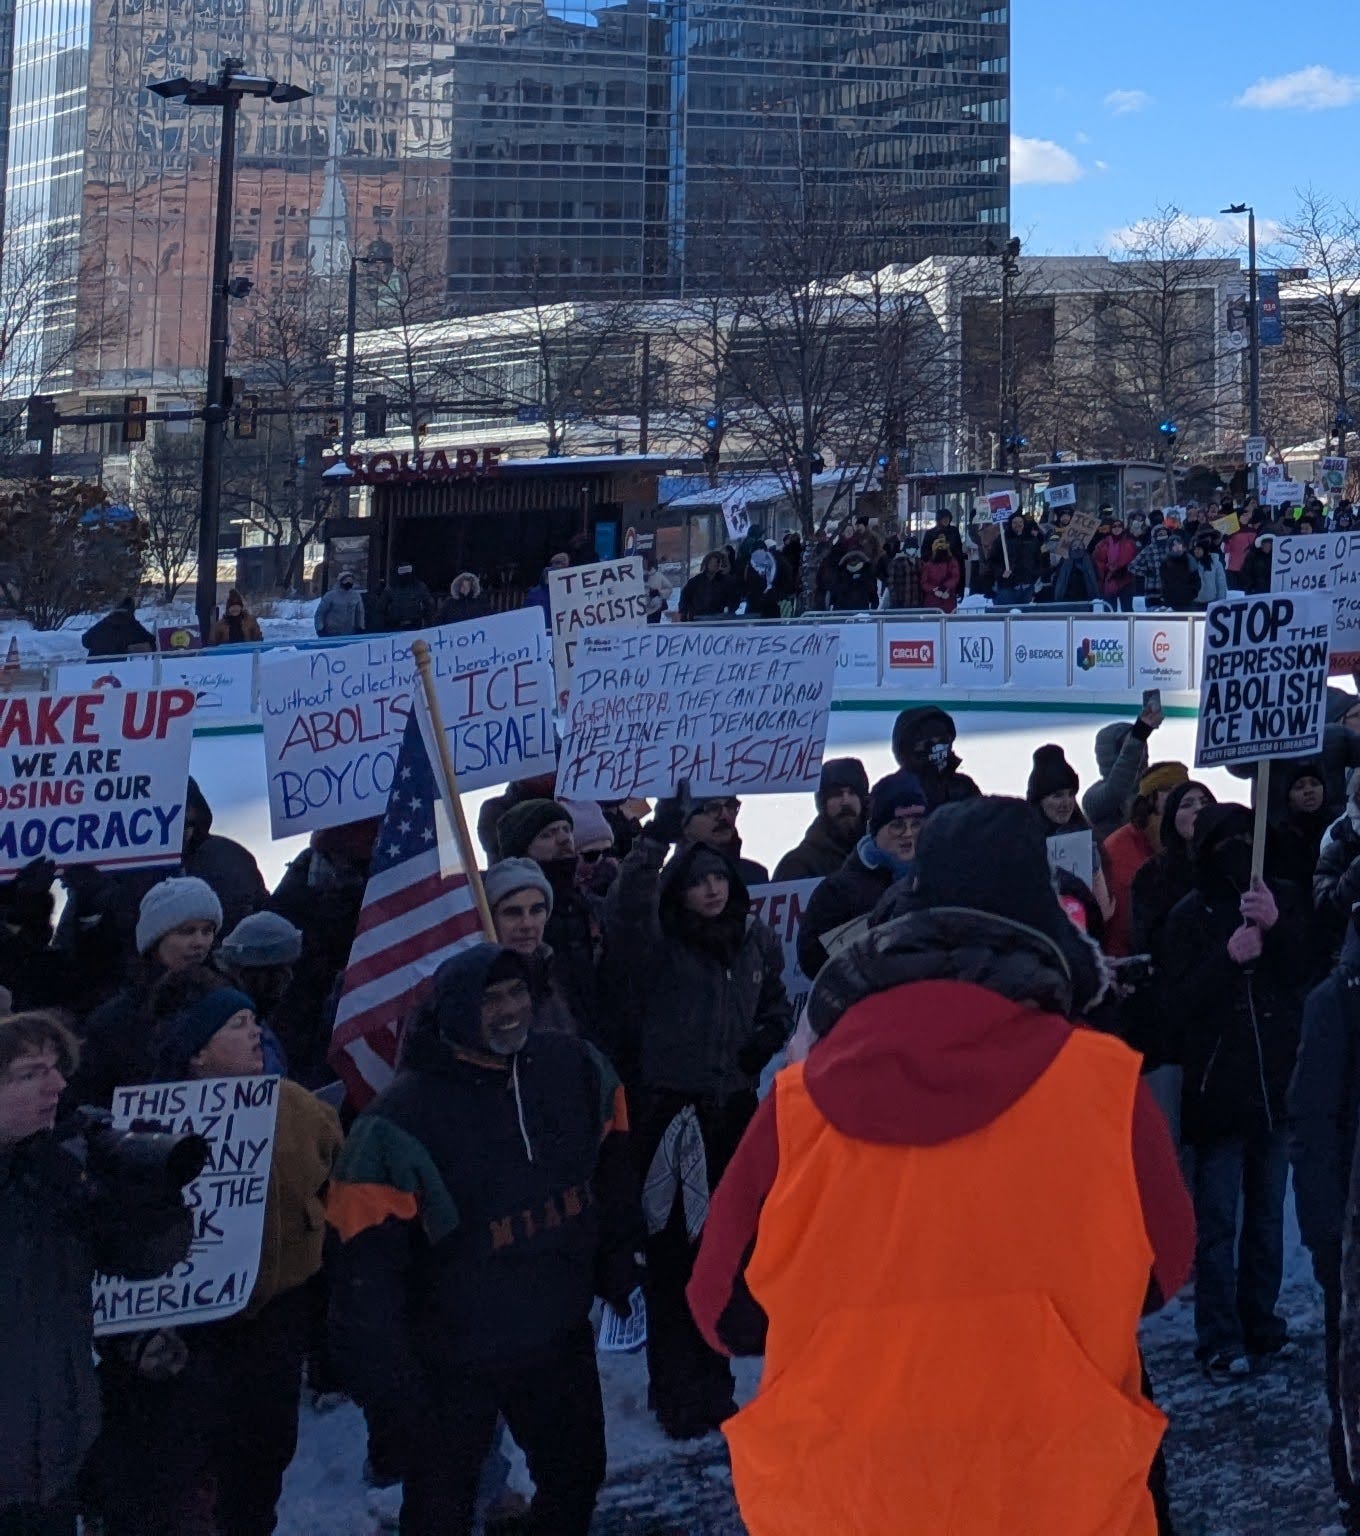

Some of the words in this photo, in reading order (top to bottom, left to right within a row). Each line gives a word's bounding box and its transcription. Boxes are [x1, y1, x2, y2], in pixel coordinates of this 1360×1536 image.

[1249, 451, 1262, 462] 10
[1278, 538, 1327, 565] SOME
[558, 564, 635, 594] TEAR
[1275, 567, 1327, 591] THOSE
[556, 593, 648, 635] FASCISTS
[1208, 599, 1294, 648] STOP
[622, 635, 652, 661] IF
[1091, 638, 1119, 651] BLOCK
[1287, 624, 1328, 641] THE
[435, 635, 542, 678] Liberation!
[959, 636, 994, 663] K&D
[1028, 649, 1064, 660] BEDROCK
[1096, 651, 1124, 663] BLOCK
[1204, 641, 1328, 681] REPRESSION
[577, 669, 650, 694] DRAW
[658, 662, 709, 685] THE
[716, 661, 761, 684] LINE
[767, 661, 803, 681] AT
[1203, 669, 1325, 716] ABOLISH
[279, 693, 410, 760] ABOLIS
[452, 659, 538, 721] ICE
[676, 692, 721, 713] THEY
[772, 680, 823, 706] DRAW
[121, 688, 195, 740] UP
[615, 718, 675, 746] LINE
[676, 714, 705, 739] AT
[708, 708, 830, 737] DEMOCRACY
[1203, 714, 1242, 747] ICE
[1250, 703, 1319, 740] NOW!
[11, 751, 57, 778] WE
[63, 748, 122, 776] ARE
[272, 742, 402, 819] BOYCO
[445, 708, 555, 776] ISRAEL
[561, 745, 660, 797] FREE
[669, 735, 826, 788] PALESTINE
[94, 775, 152, 802] OUR
[0, 804, 182, 859] MOCRACY
[119, 1086, 187, 1116] THIS
[199, 1082, 227, 1113] IS
[233, 1078, 277, 1110] NOT
[209, 1176, 265, 1208] THE
[93, 1270, 247, 1320] AMERICA!
